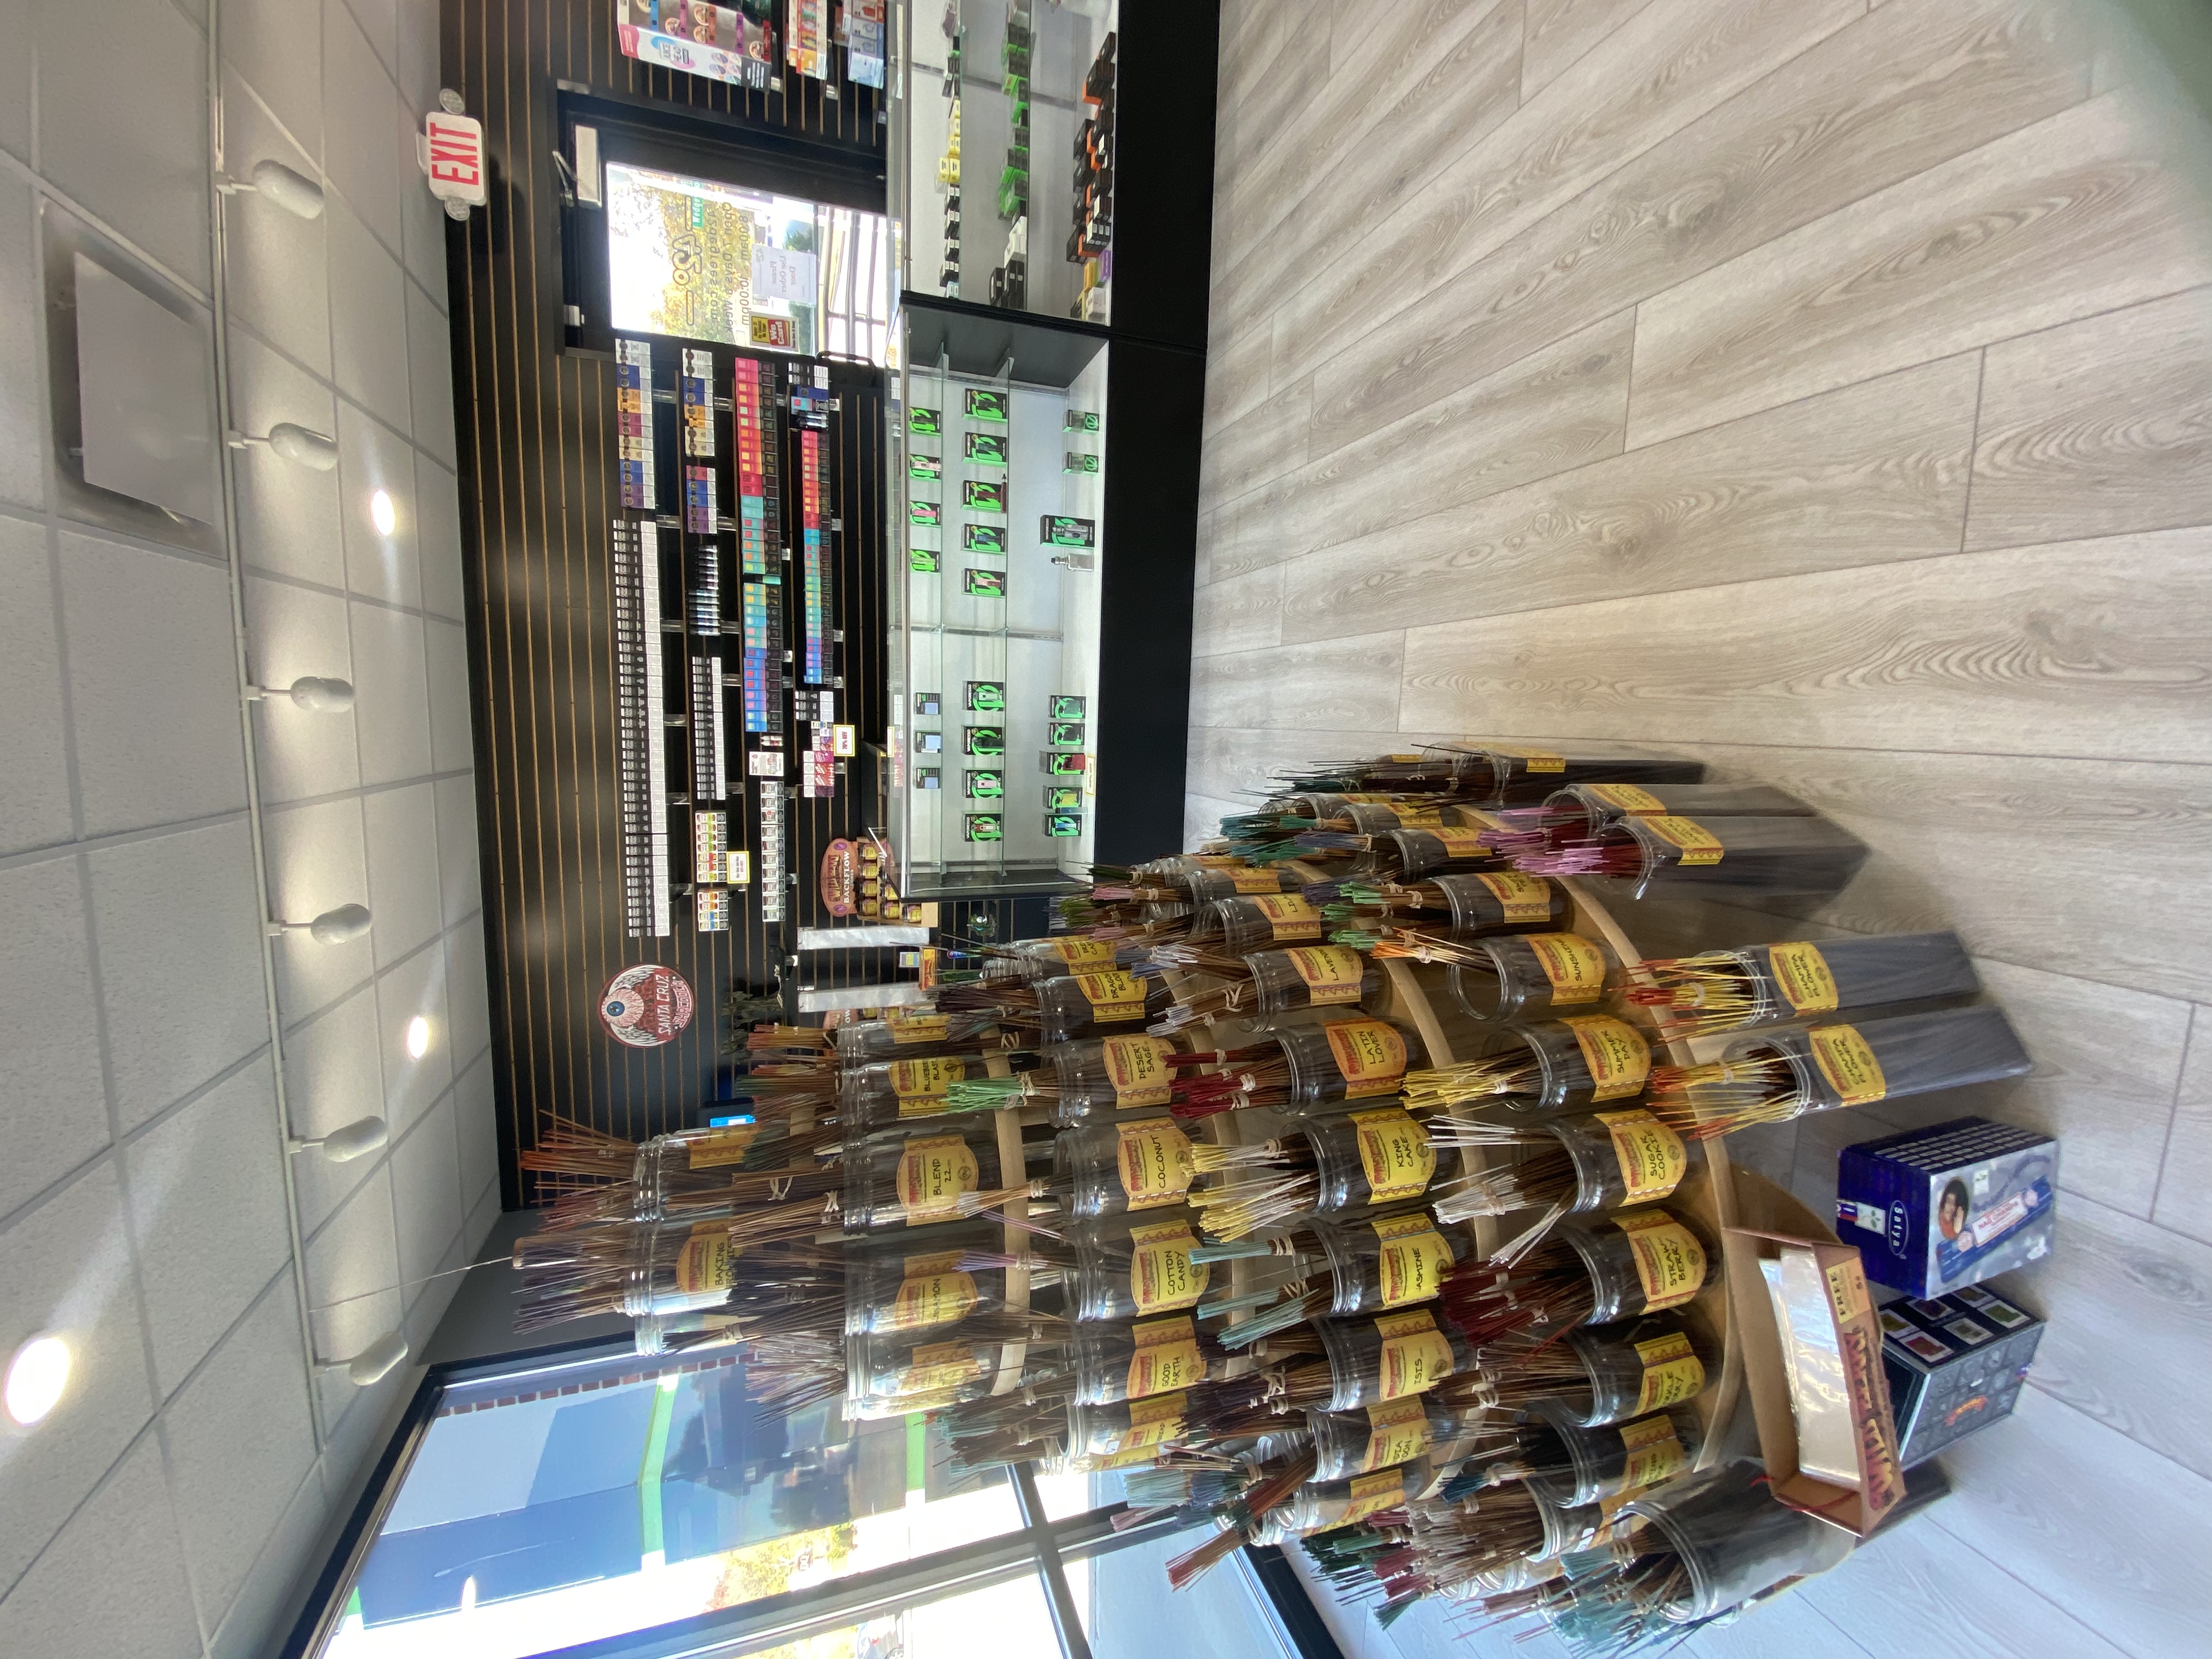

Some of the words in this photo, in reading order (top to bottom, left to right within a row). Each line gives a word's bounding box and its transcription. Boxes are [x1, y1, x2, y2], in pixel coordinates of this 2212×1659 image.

[430, 122, 479, 185] EXIT
[770, 324, 777, 340] We
[775, 321, 785, 345] Card
[1555, 938, 1582, 981] SUNSHINE
[1791, 954, 1813, 998] CHAMPA
[1797, 955, 1820, 997] FLOWER
[656, 974, 669, 1001] CRUZ
[658, 1005, 671, 1035] SANTA
[1130, 1042, 1147, 1080] DESERT
[1143, 1046, 1155, 1073] SAGE
[1358, 1030, 1377, 1064] LATIN
[1368, 1030, 1385, 1063] LOVER
[1601, 1030, 1625, 1073] SUMMER
[1615, 1037, 1630, 1060] DAY
[1832, 1039, 1859, 1085] CHAMPA
[1839, 1038, 1866, 1083] FLOWER
[1150, 1135, 1166, 1188] COCONUT
[1392, 1138, 1404, 1167] KING
[1401, 1137, 1414, 1167] CAKE
[1640, 1135, 1658, 1176] SUGAR
[1647, 1129, 1666, 1180] COOKIE
[933, 1159, 942, 1195] BLEND
[945, 1168, 951, 1183] 22
[1893, 1206, 1904, 1247] Satya
[715, 1243, 725, 1285] BAKING
[1164, 1250, 1175, 1295] COTTON
[1175, 1251, 1186, 1291] CANDY
[1413, 1248, 1424, 1291] JASMINE
[1665, 1238, 1686, 1280] BERRY
[1830, 1272, 1846, 1316] FREE
[1162, 1363, 1171, 1387] GOOD
[1171, 1357, 1181, 1387] EARTH
[1414, 1359, 1423, 1384] ISIS
